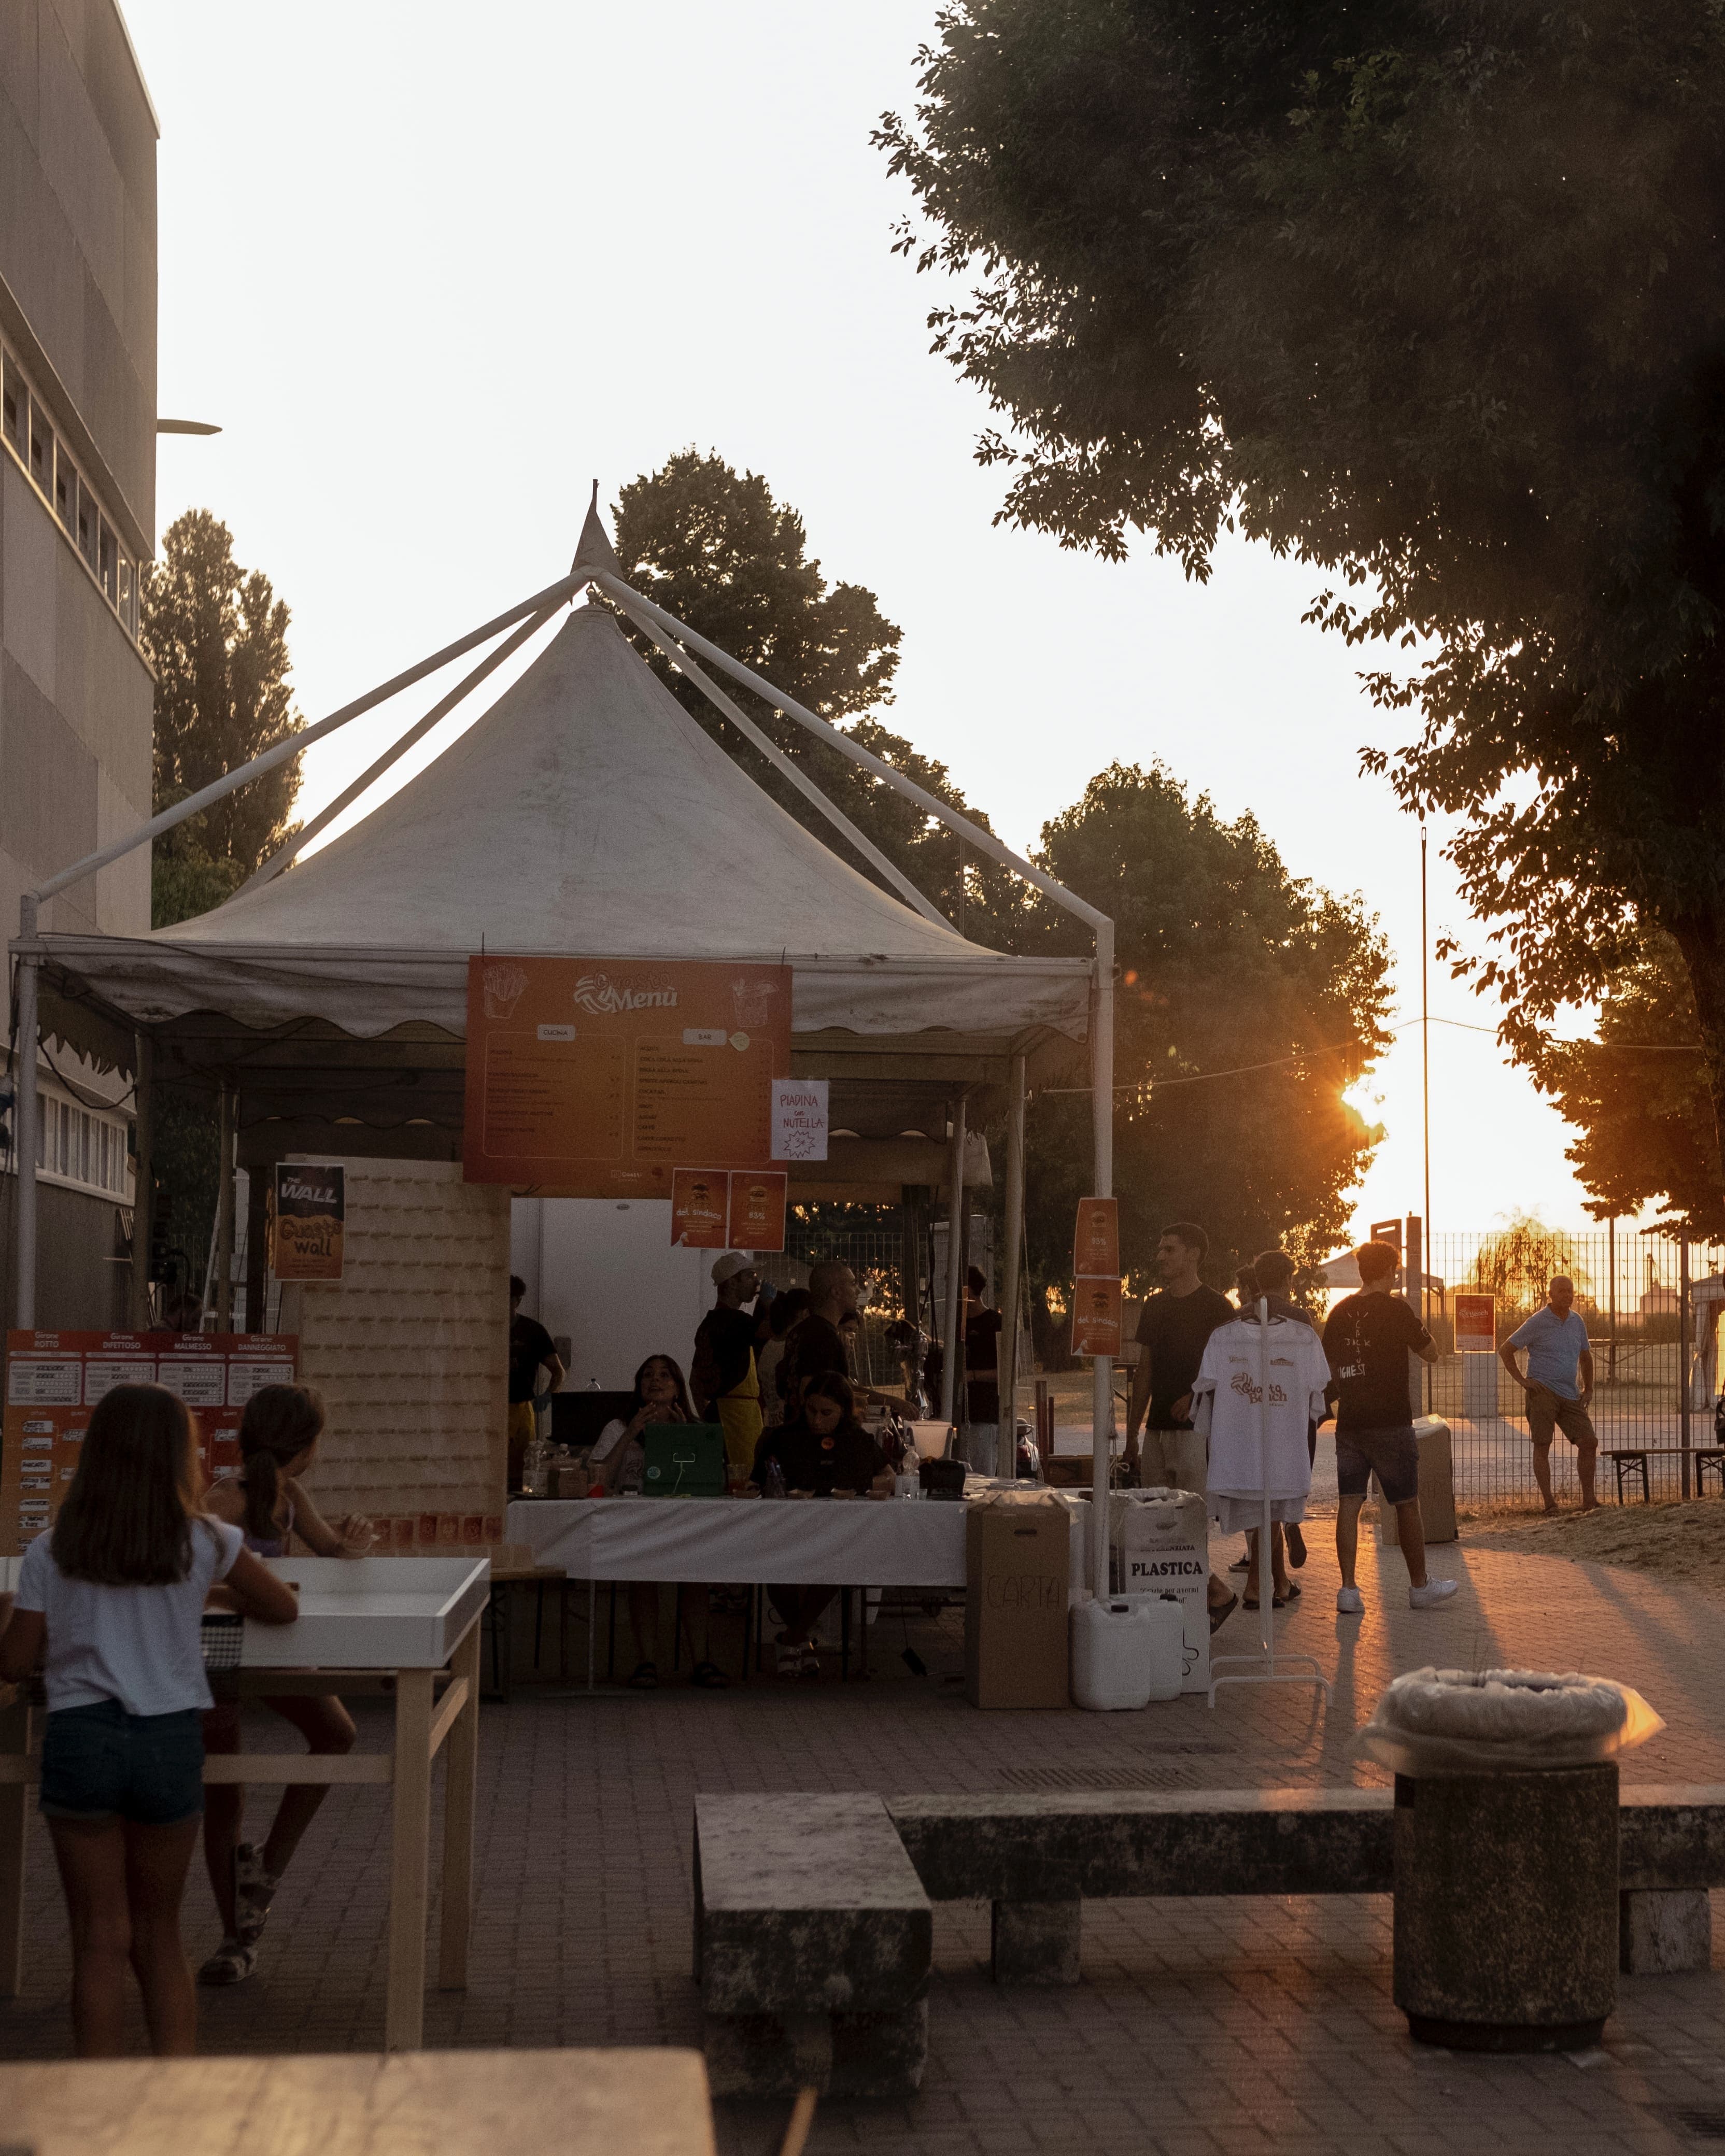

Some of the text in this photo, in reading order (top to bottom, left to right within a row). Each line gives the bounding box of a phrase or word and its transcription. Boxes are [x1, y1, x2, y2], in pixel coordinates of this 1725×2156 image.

[593, 970, 671, 990] Guasto
[610, 986, 678, 1013] Menù
[780, 1094, 818, 1108] PIADINA
[783, 1117, 825, 1129] NUTELLA
[280, 1184, 338, 1204] WALL
[676, 1207, 723, 1220] del sindaco
[279, 1218, 342, 1240] Guasto
[294, 1238, 332, 1257] wall
[1077, 1315, 1119, 1328] del sindaco
[34, 1331, 60, 1340] Girone
[182, 1334, 205, 1342] Girone
[34, 1340, 60, 1349] ROTTO
[103, 1341, 141, 1350] DIFETTOSO
[174, 1342, 212, 1351] MALMESSO
[1242, 1382, 1282, 1394] Guato
[1249, 1392, 1288, 1404] Bech
[1132, 1561, 1203, 1577] PLASTICA
[986, 1575, 1062, 1609] CARTA
